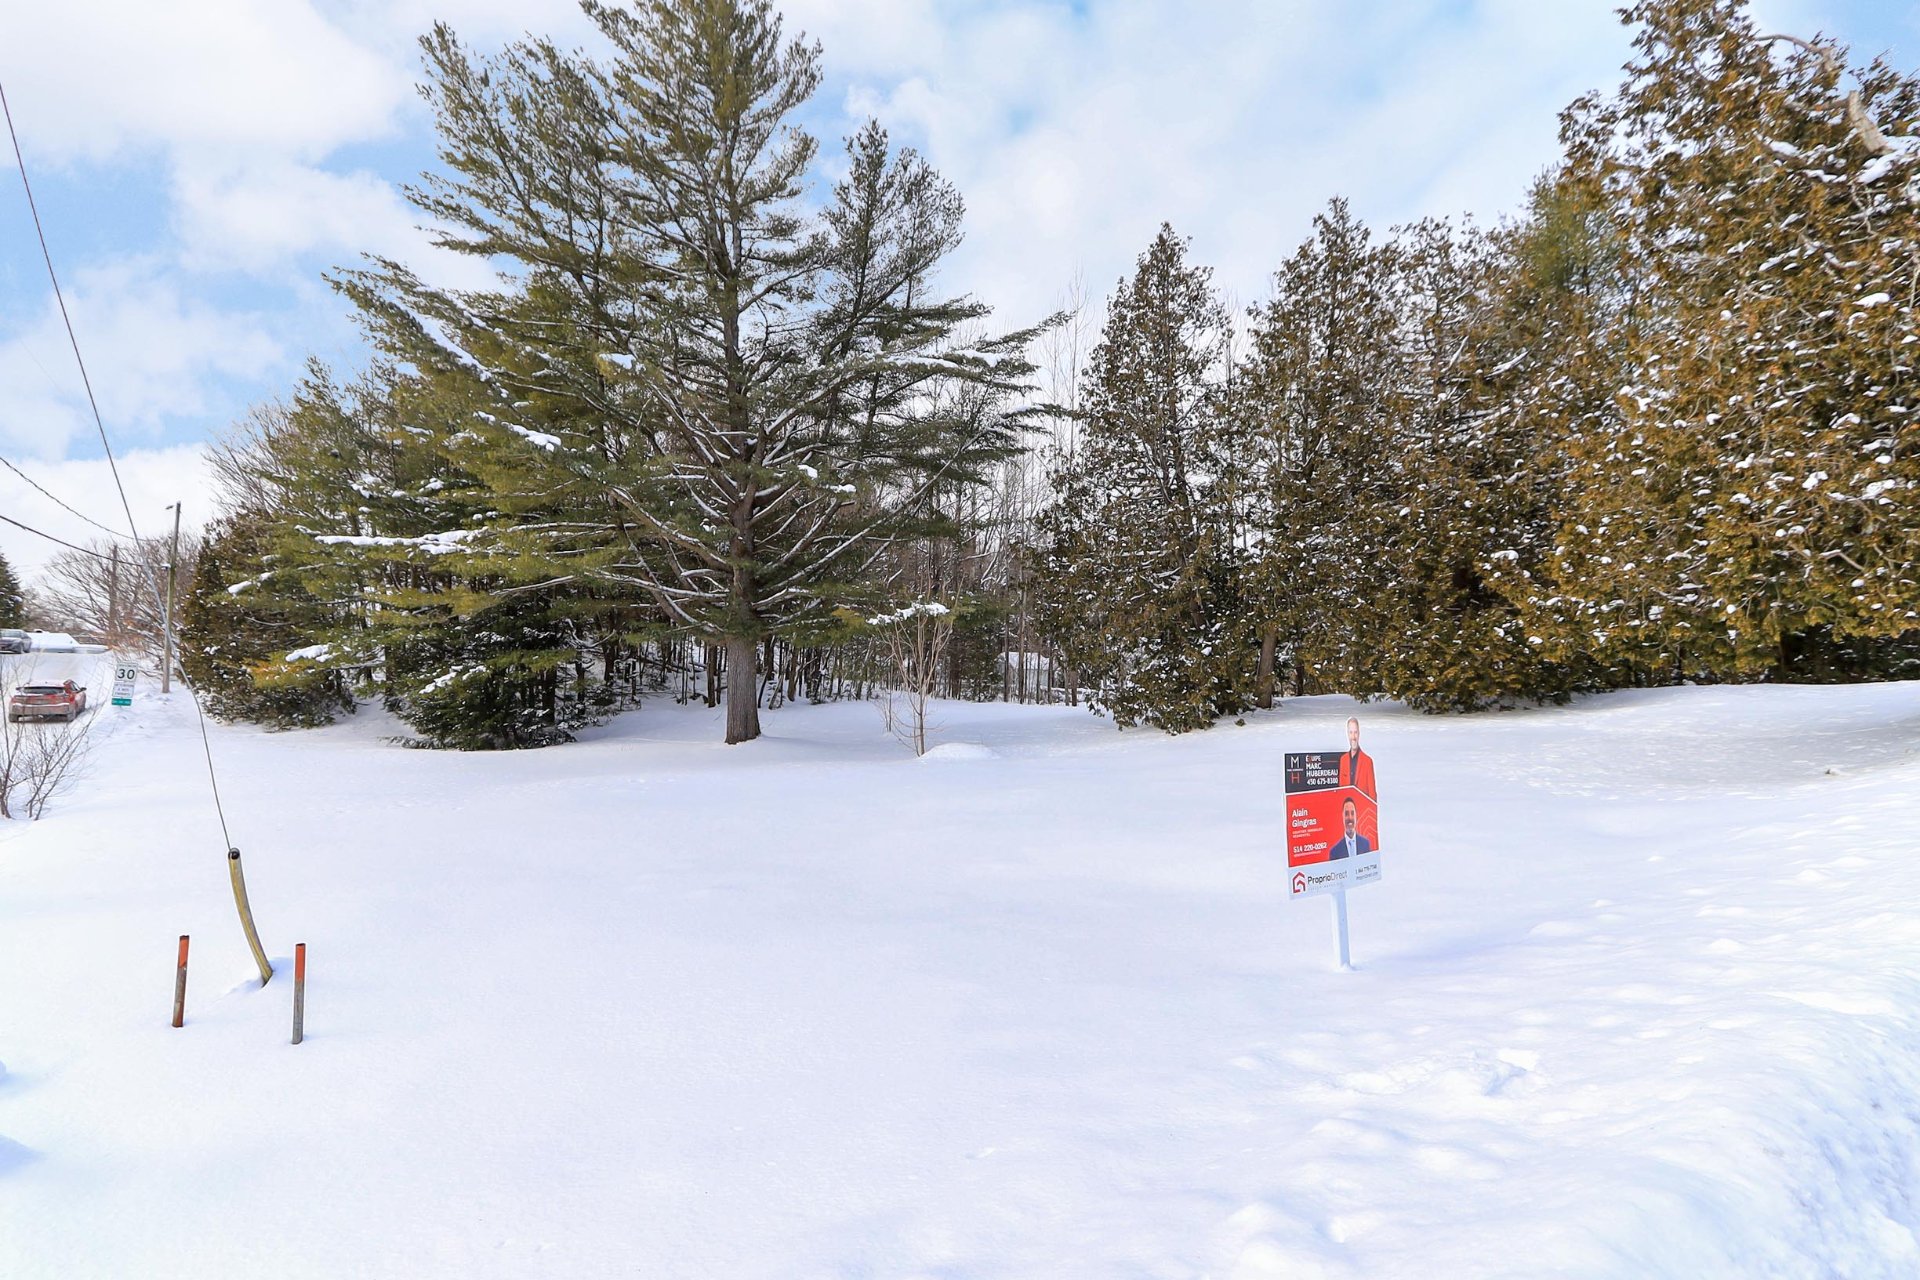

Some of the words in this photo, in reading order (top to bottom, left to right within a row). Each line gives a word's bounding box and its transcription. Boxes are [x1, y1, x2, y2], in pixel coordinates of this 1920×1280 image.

[117, 668, 135, 680] 30
[1290, 756, 1300, 768] M
[1291, 772, 1300, 784] H
[1306, 769, 1338, 777] HUBERDEAU
[1292, 808, 1308, 817] Alain
[1292, 818, 1316, 828] Gingras
[1293, 845, 1303, 853] 514
[1308, 870, 1347, 885] ProprioDirect
